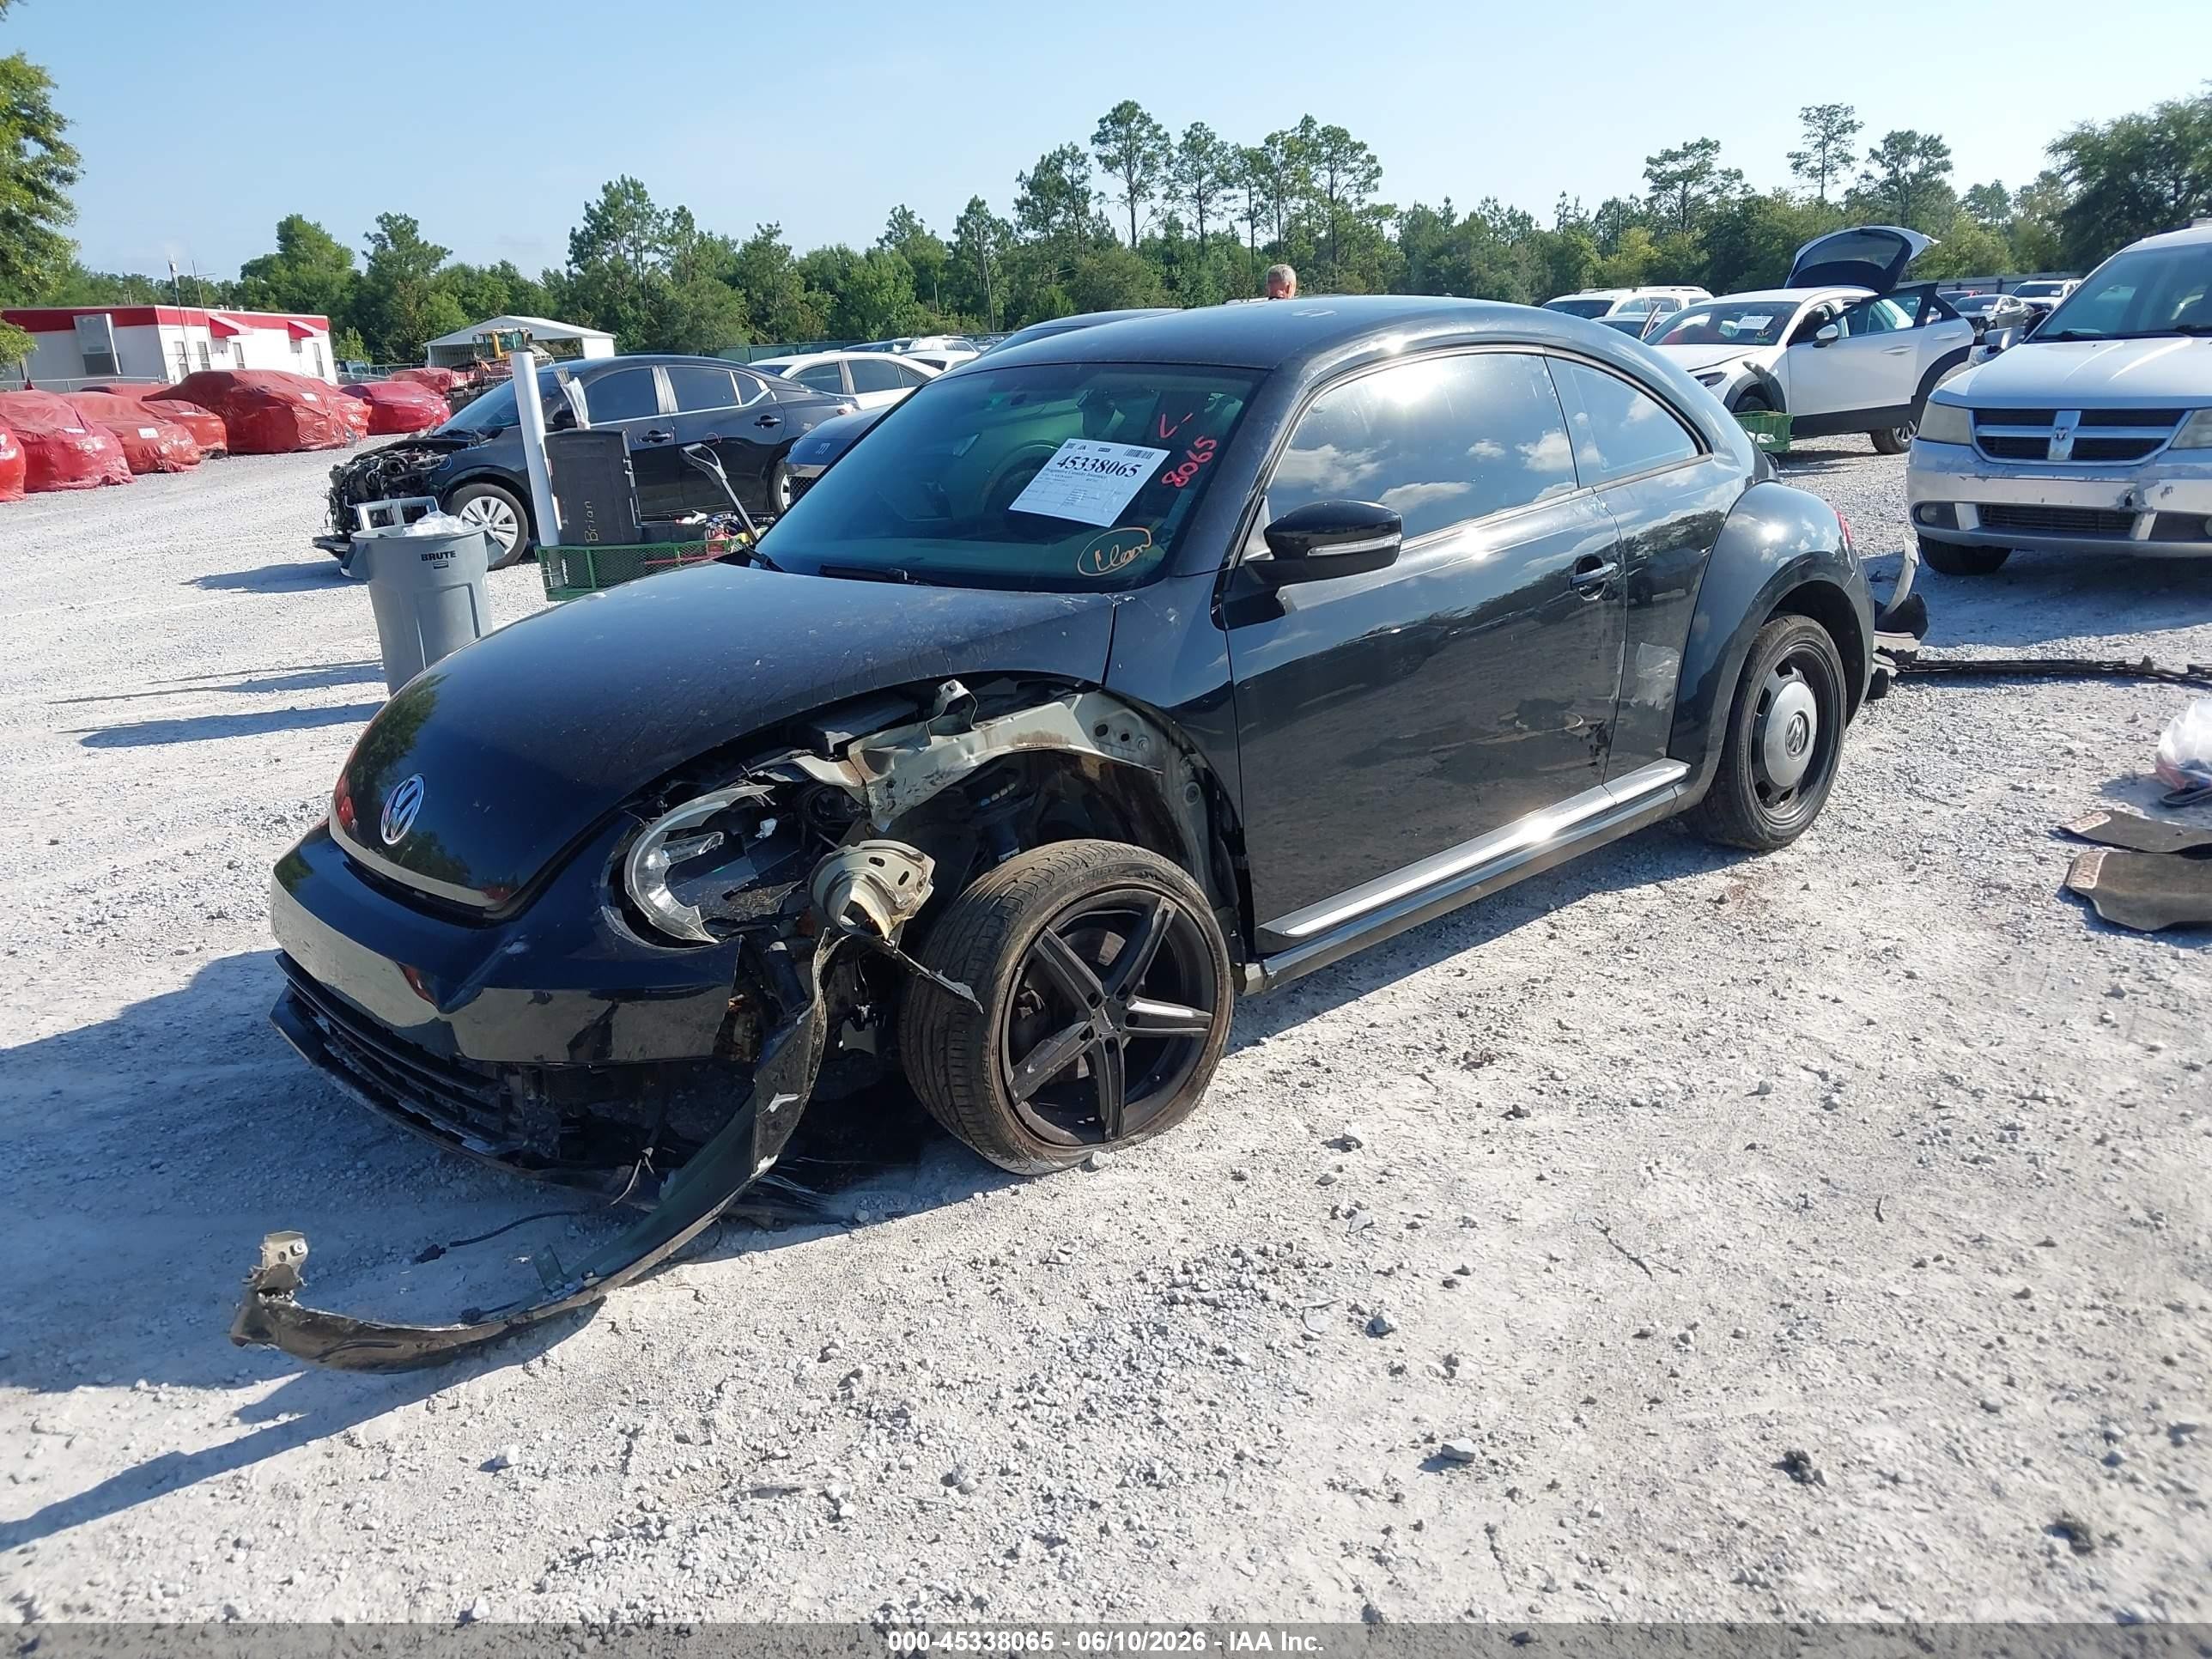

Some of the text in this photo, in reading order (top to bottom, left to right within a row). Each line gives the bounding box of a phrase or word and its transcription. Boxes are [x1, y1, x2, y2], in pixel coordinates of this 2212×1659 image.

[1057, 455, 1142, 477] 45338065
[1161, 435, 1217, 488] 8065
[584, 501, 599, 543] Brian
[421, 550, 456, 561] BRUTE
